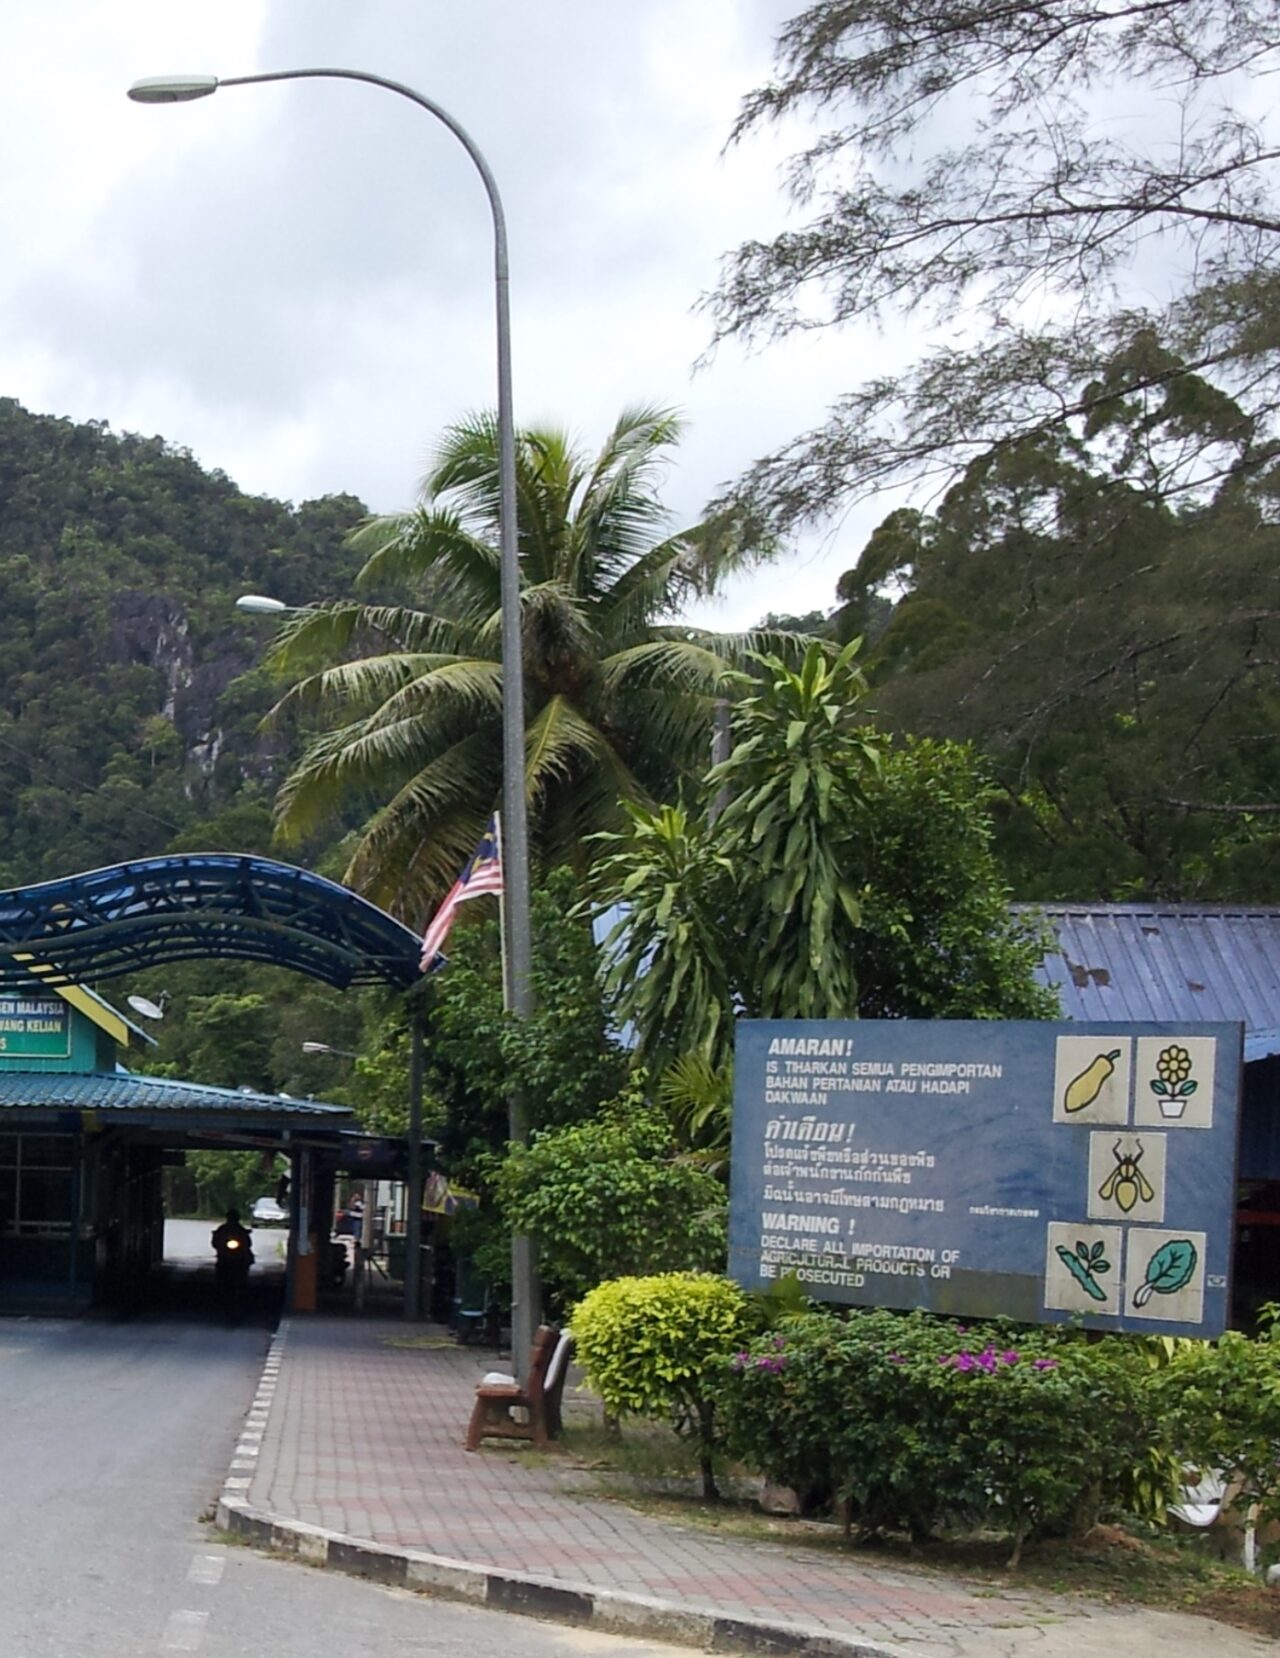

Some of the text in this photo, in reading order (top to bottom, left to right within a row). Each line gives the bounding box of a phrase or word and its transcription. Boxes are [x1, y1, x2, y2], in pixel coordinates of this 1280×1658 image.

[16, 1002, 64, 1015] MALAYSIA
[27, 1020, 62, 1033] KELIAN
[852, 1062, 894, 1077] SEMUA
[901, 1063, 1002, 1078] PENGIMPORTAN
[766, 1076, 970, 1094] BAHAN PERTANIAN ATAU HADAPI
[765, 1090, 827, 1105] DAKWAAN
[761, 1212, 840, 1235] WARNING
[761, 1235, 960, 1264] DECLARE ALL IMPORTATION OF
[760, 1264, 776, 1279] BE
[856, 1259, 925, 1277] PRODUCTS
[931, 1265, 951, 1279] OR
